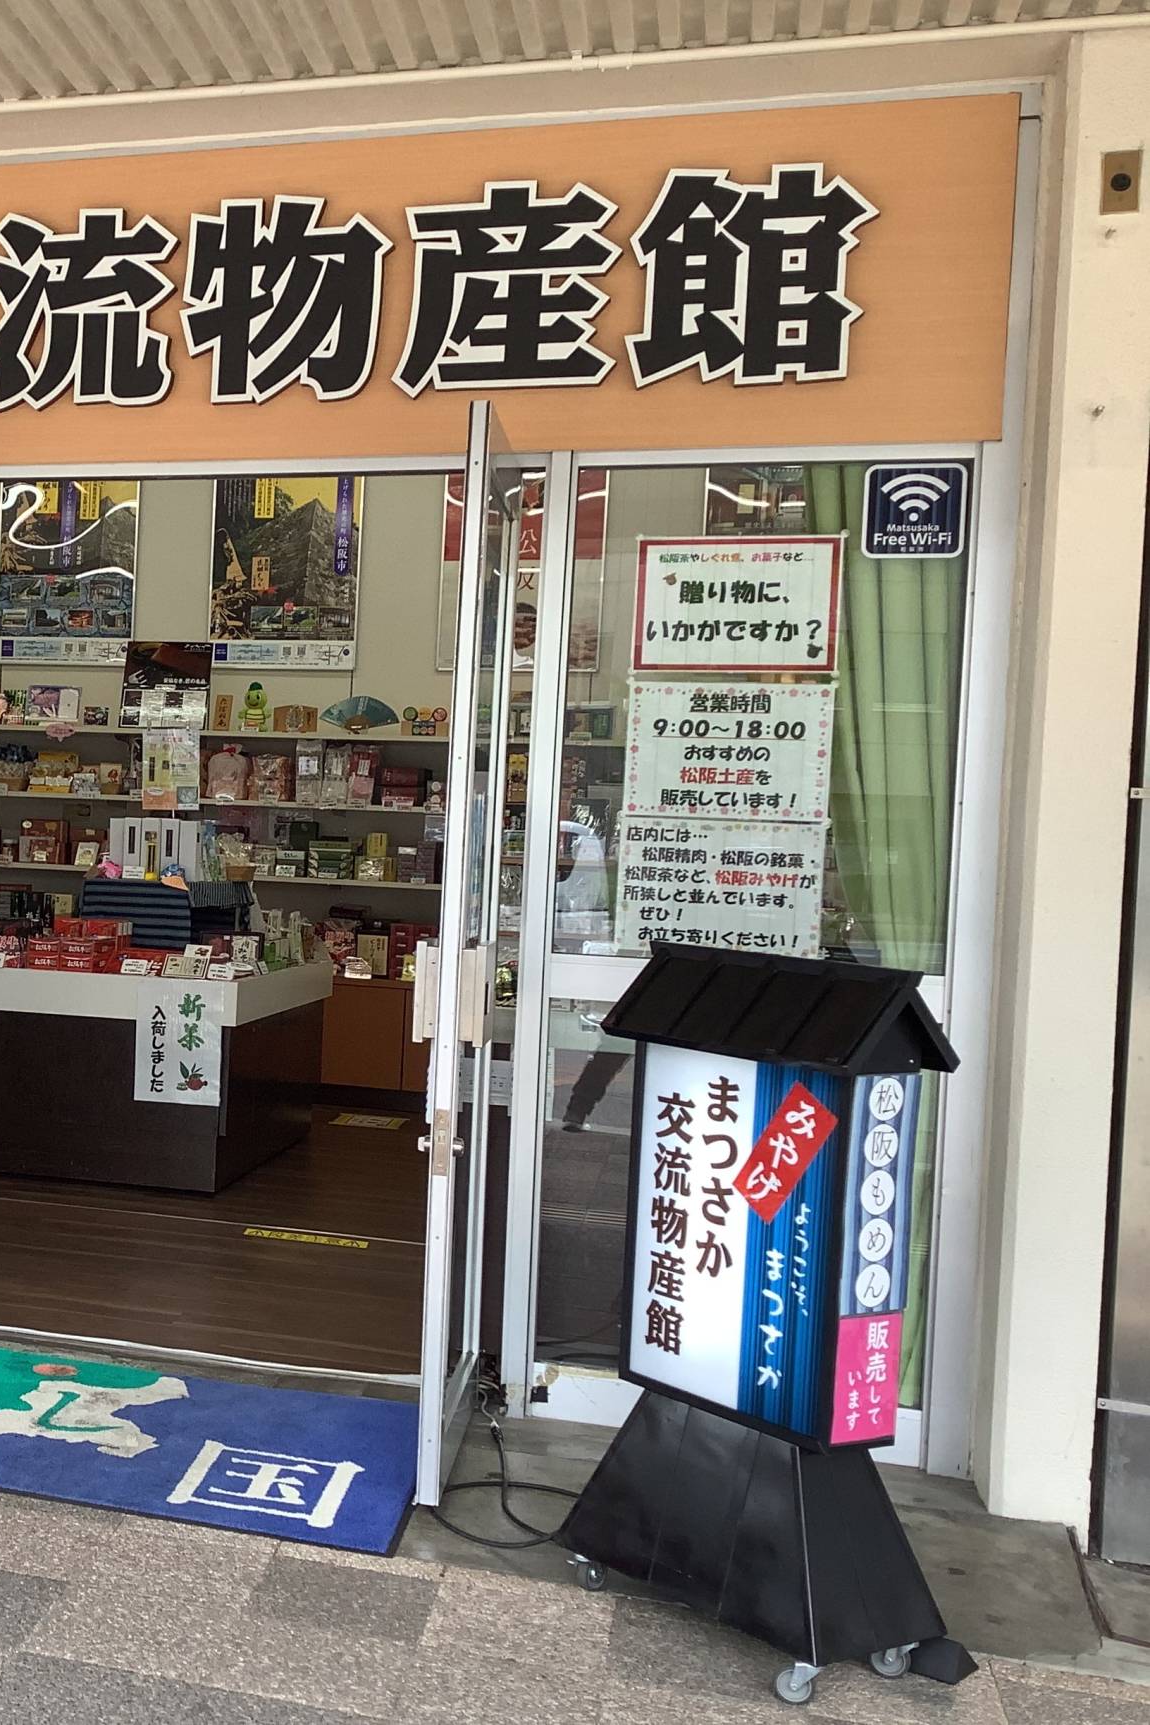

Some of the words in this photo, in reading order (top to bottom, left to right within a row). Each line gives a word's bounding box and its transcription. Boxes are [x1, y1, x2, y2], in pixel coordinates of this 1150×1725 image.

[873, 532, 907, 546] Free
[910, 531, 953, 546] Wi-Fi
[886, 523, 941, 533] Matsusaka
[337, 536, 349, 572] 松阪市
[679, 579, 790, 604] 贈り物に、
[646, 618, 823, 642] いかがですか？
[689, 693, 771, 713] 営業時間
[683, 745, 771, 762] おすすめの
[680, 766, 772, 786] 松阪土産を
[661, 788, 797, 808] 販売しています！
[624, 866, 816, 889] 松阪茶など、松阪みやげが
[623, 885, 795, 910] 所狭しと並んでいます。
[639, 907, 684, 921] ぜひ！
[637, 926, 799, 949] お立ち寄りください！
[177, 993, 206, 1051] 新茶
[149, 1005, 167, 1092] 入荷しました
[745, 1100, 818, 1200] みやげ
[695, 1075, 742, 1278] まつさか
[865, 1082, 900, 1300] 松阪もめん
[644, 1091, 696, 1356] 交流物産館
[757, 1248, 785, 1390] まつさか
[866, 1320, 891, 1426] 販売して
[845, 1369, 863, 1432] います
